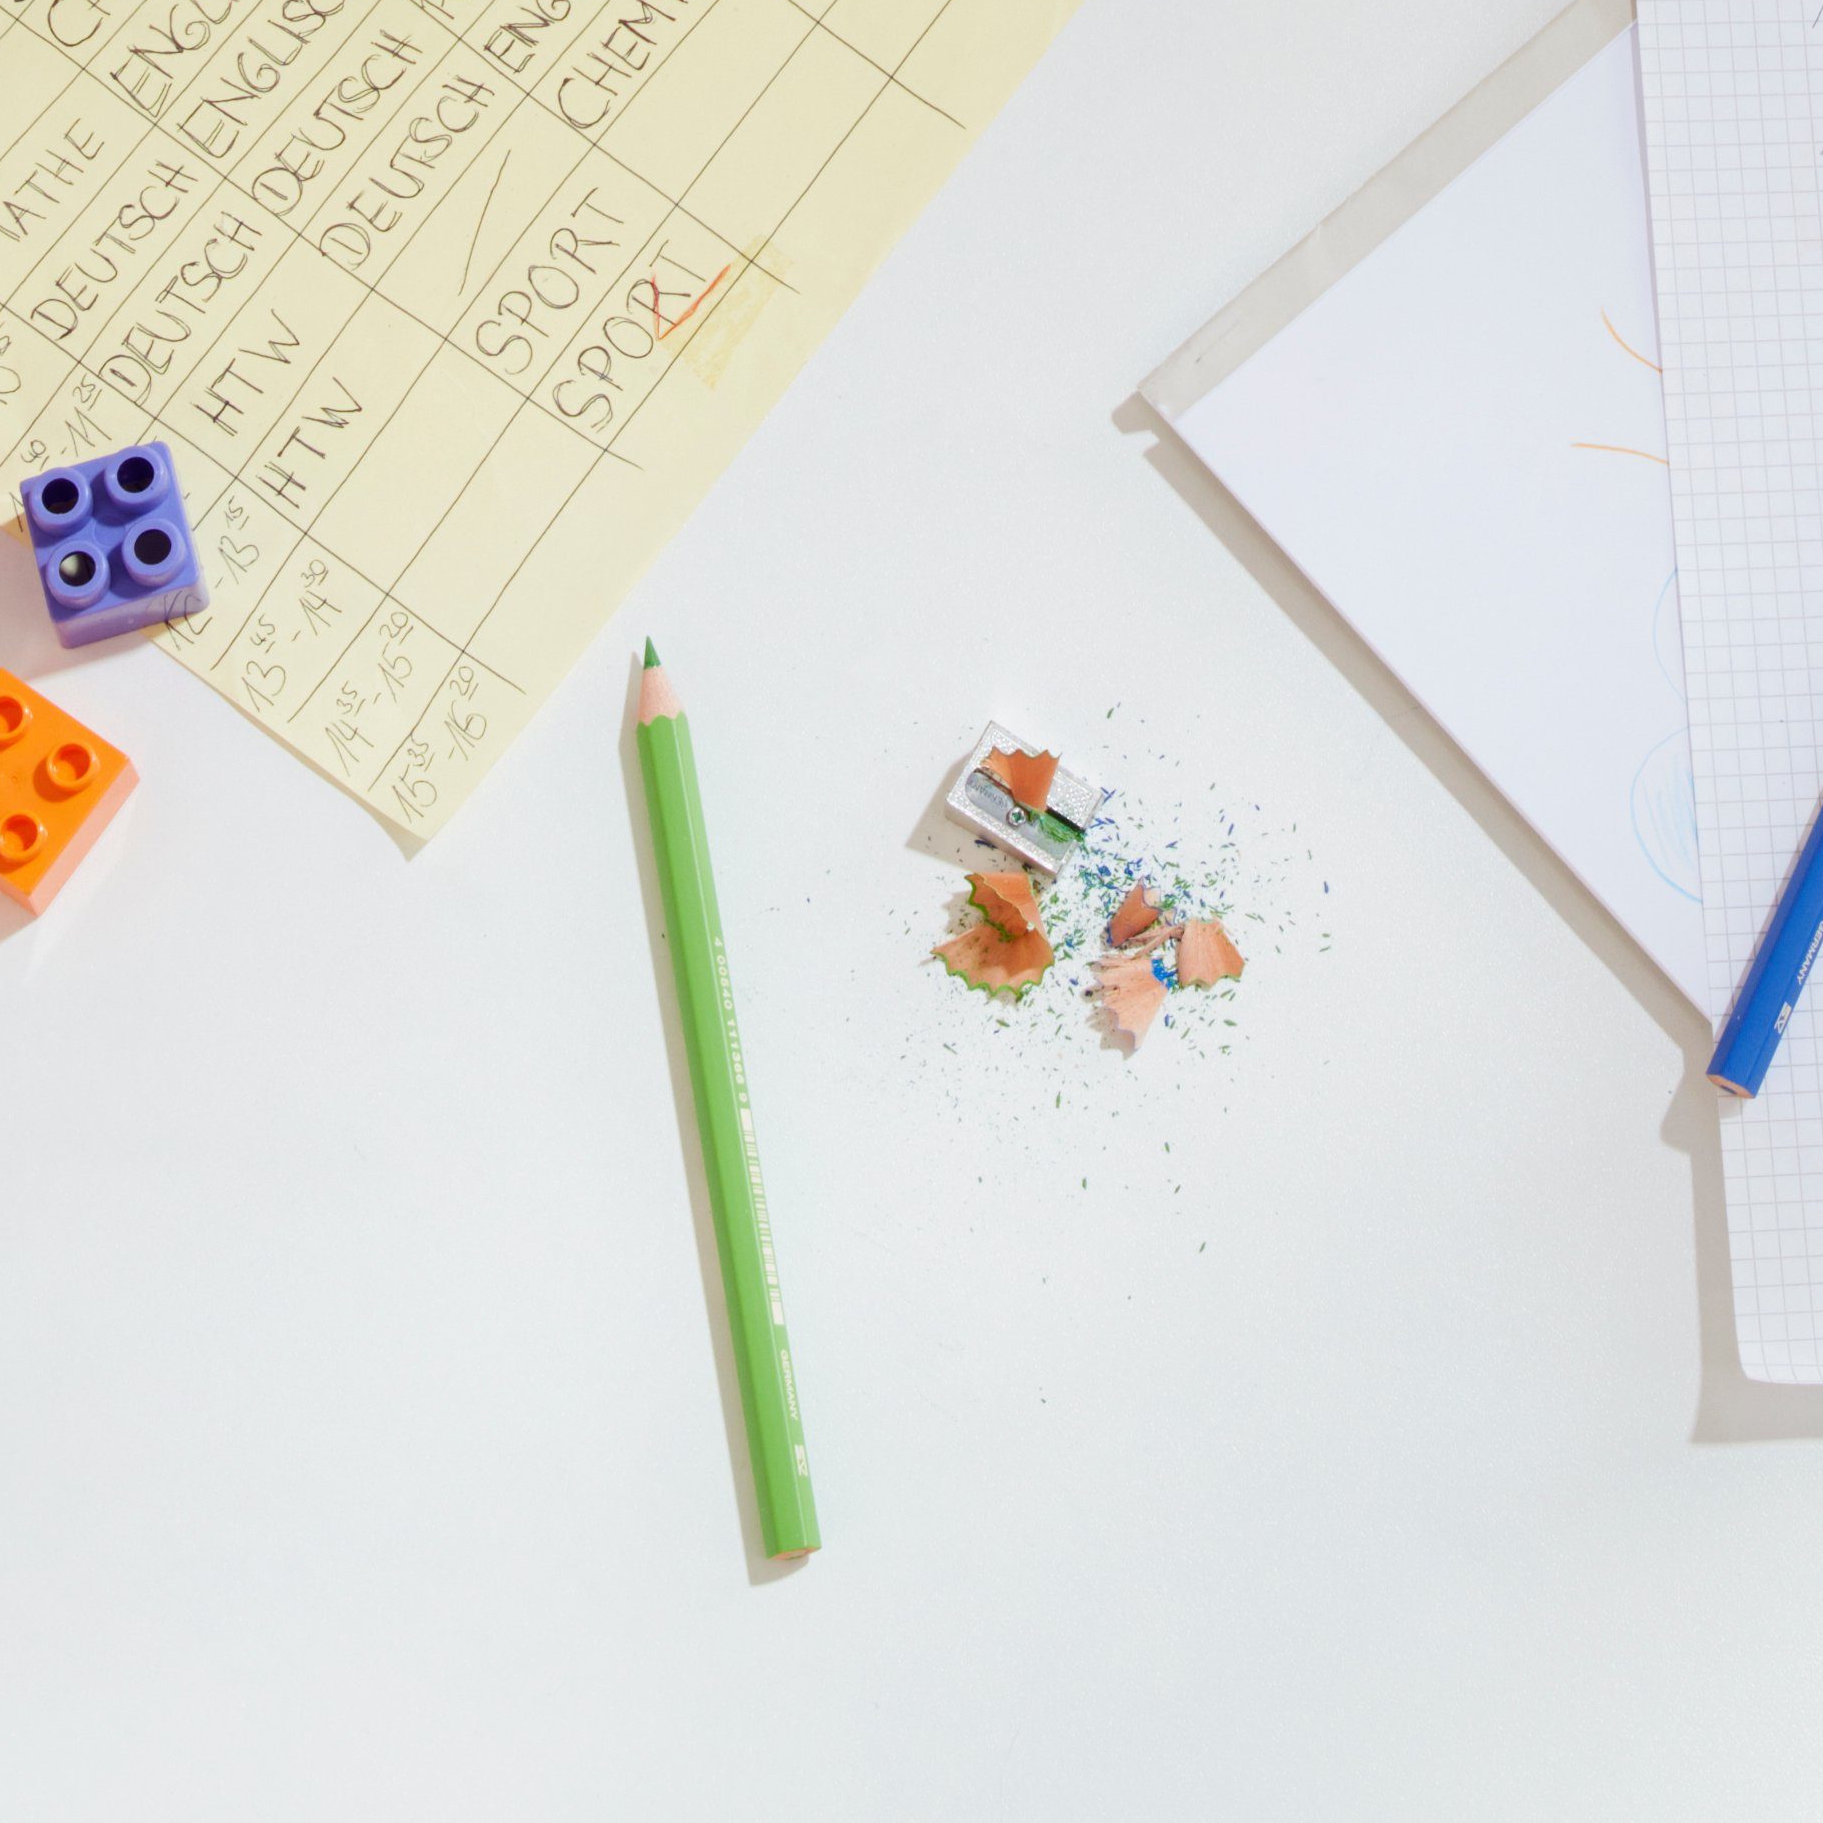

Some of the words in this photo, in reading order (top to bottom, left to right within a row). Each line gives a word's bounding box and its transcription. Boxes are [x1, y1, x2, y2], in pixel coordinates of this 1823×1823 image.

[28, 158, 199, 348] DEUTSCH
[96, 209, 263, 409] DEUTSCH
[246, 28, 424, 224] DEUTSCH
[188, 307, 301, 438] HTW
[317, 73, 495, 270] DEUTSCH
[475, 186, 627, 377] SPORT
[550, 238, 710, 434] SPORT
[254, 375, 364, 510] HTW
[714, 936, 723, 948] 4
[716, 954, 734, 1011] 00540
[780, 1348, 799, 1421] GERMANY
